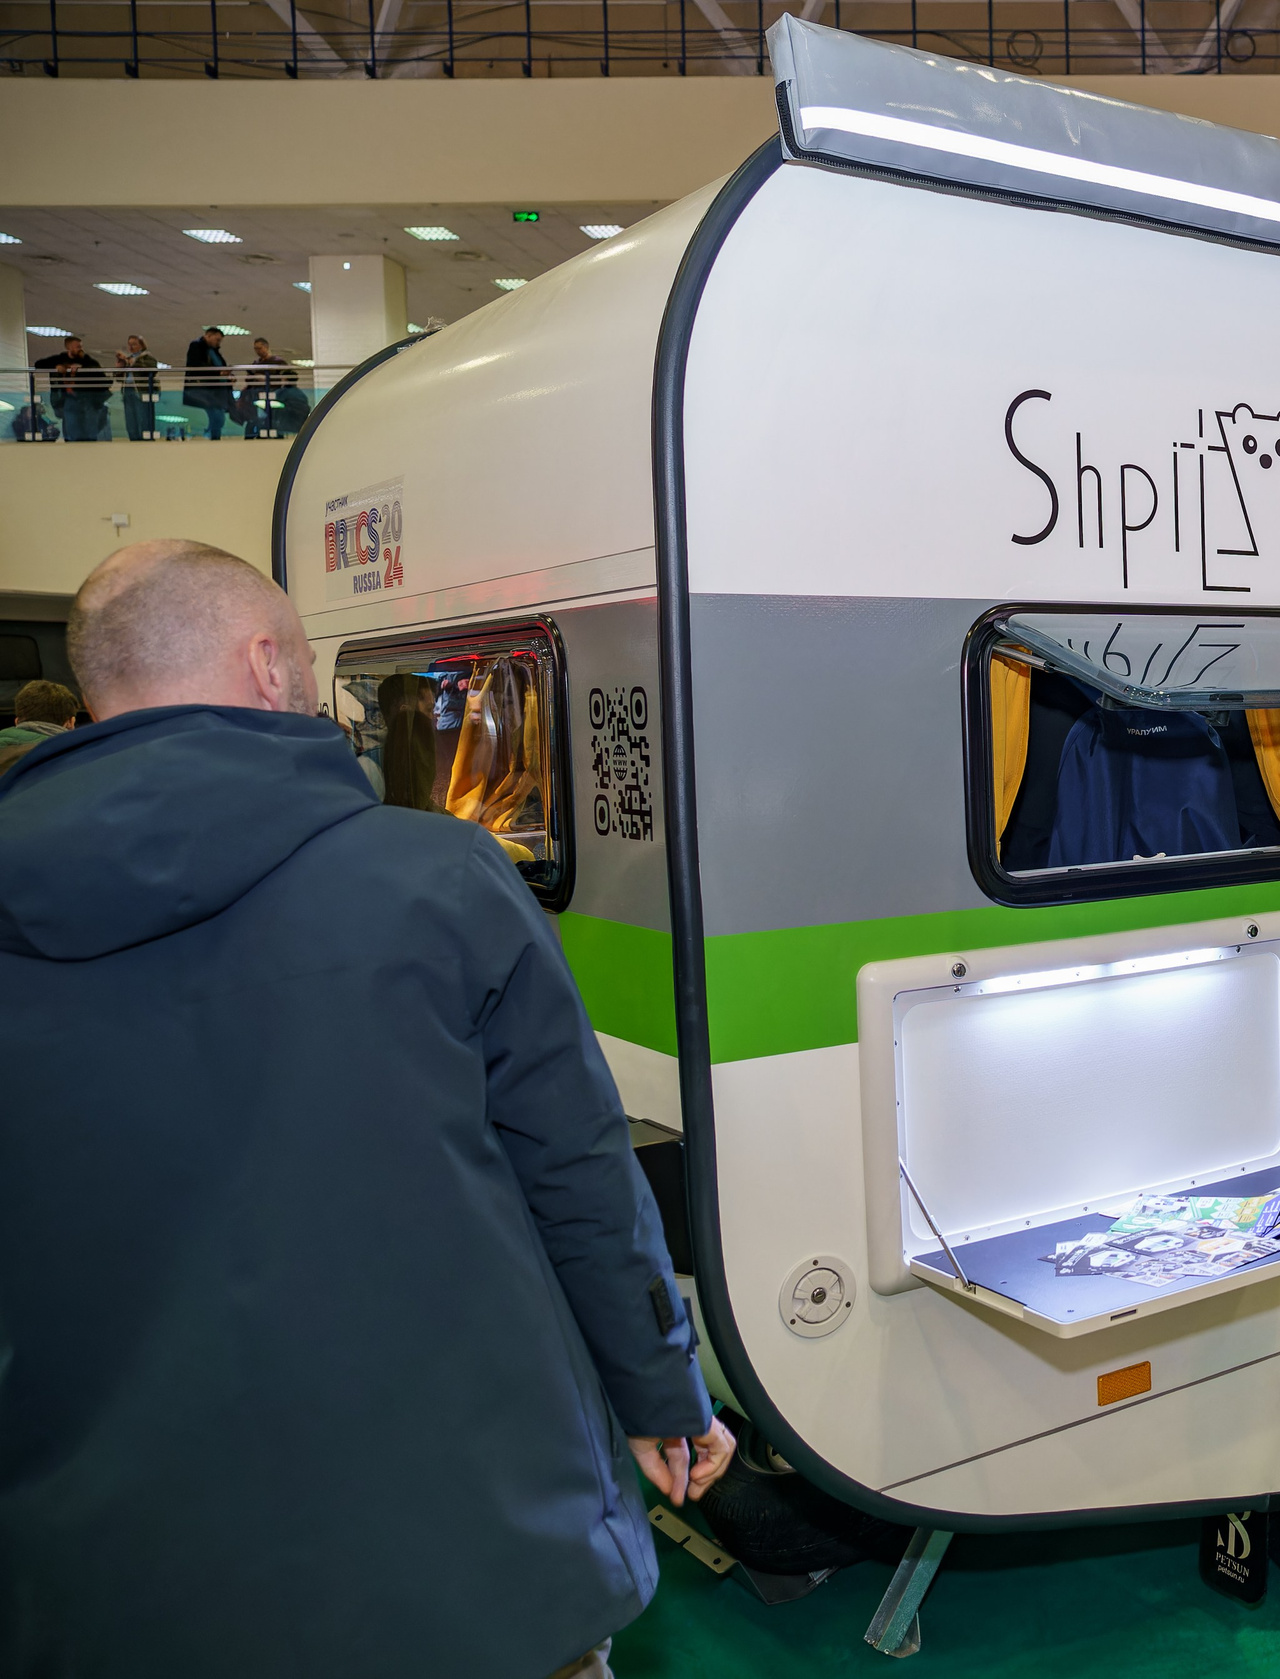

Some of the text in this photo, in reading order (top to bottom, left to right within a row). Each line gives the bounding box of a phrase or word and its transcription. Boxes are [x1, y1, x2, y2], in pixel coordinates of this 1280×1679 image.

[325, 500, 402, 573] BRICS 20
[353, 545, 404, 594] RUSSIA 24
[1215, 1551, 1250, 1578] PETSUN
[1217, 1564, 1245, 1584] petsun.ru
